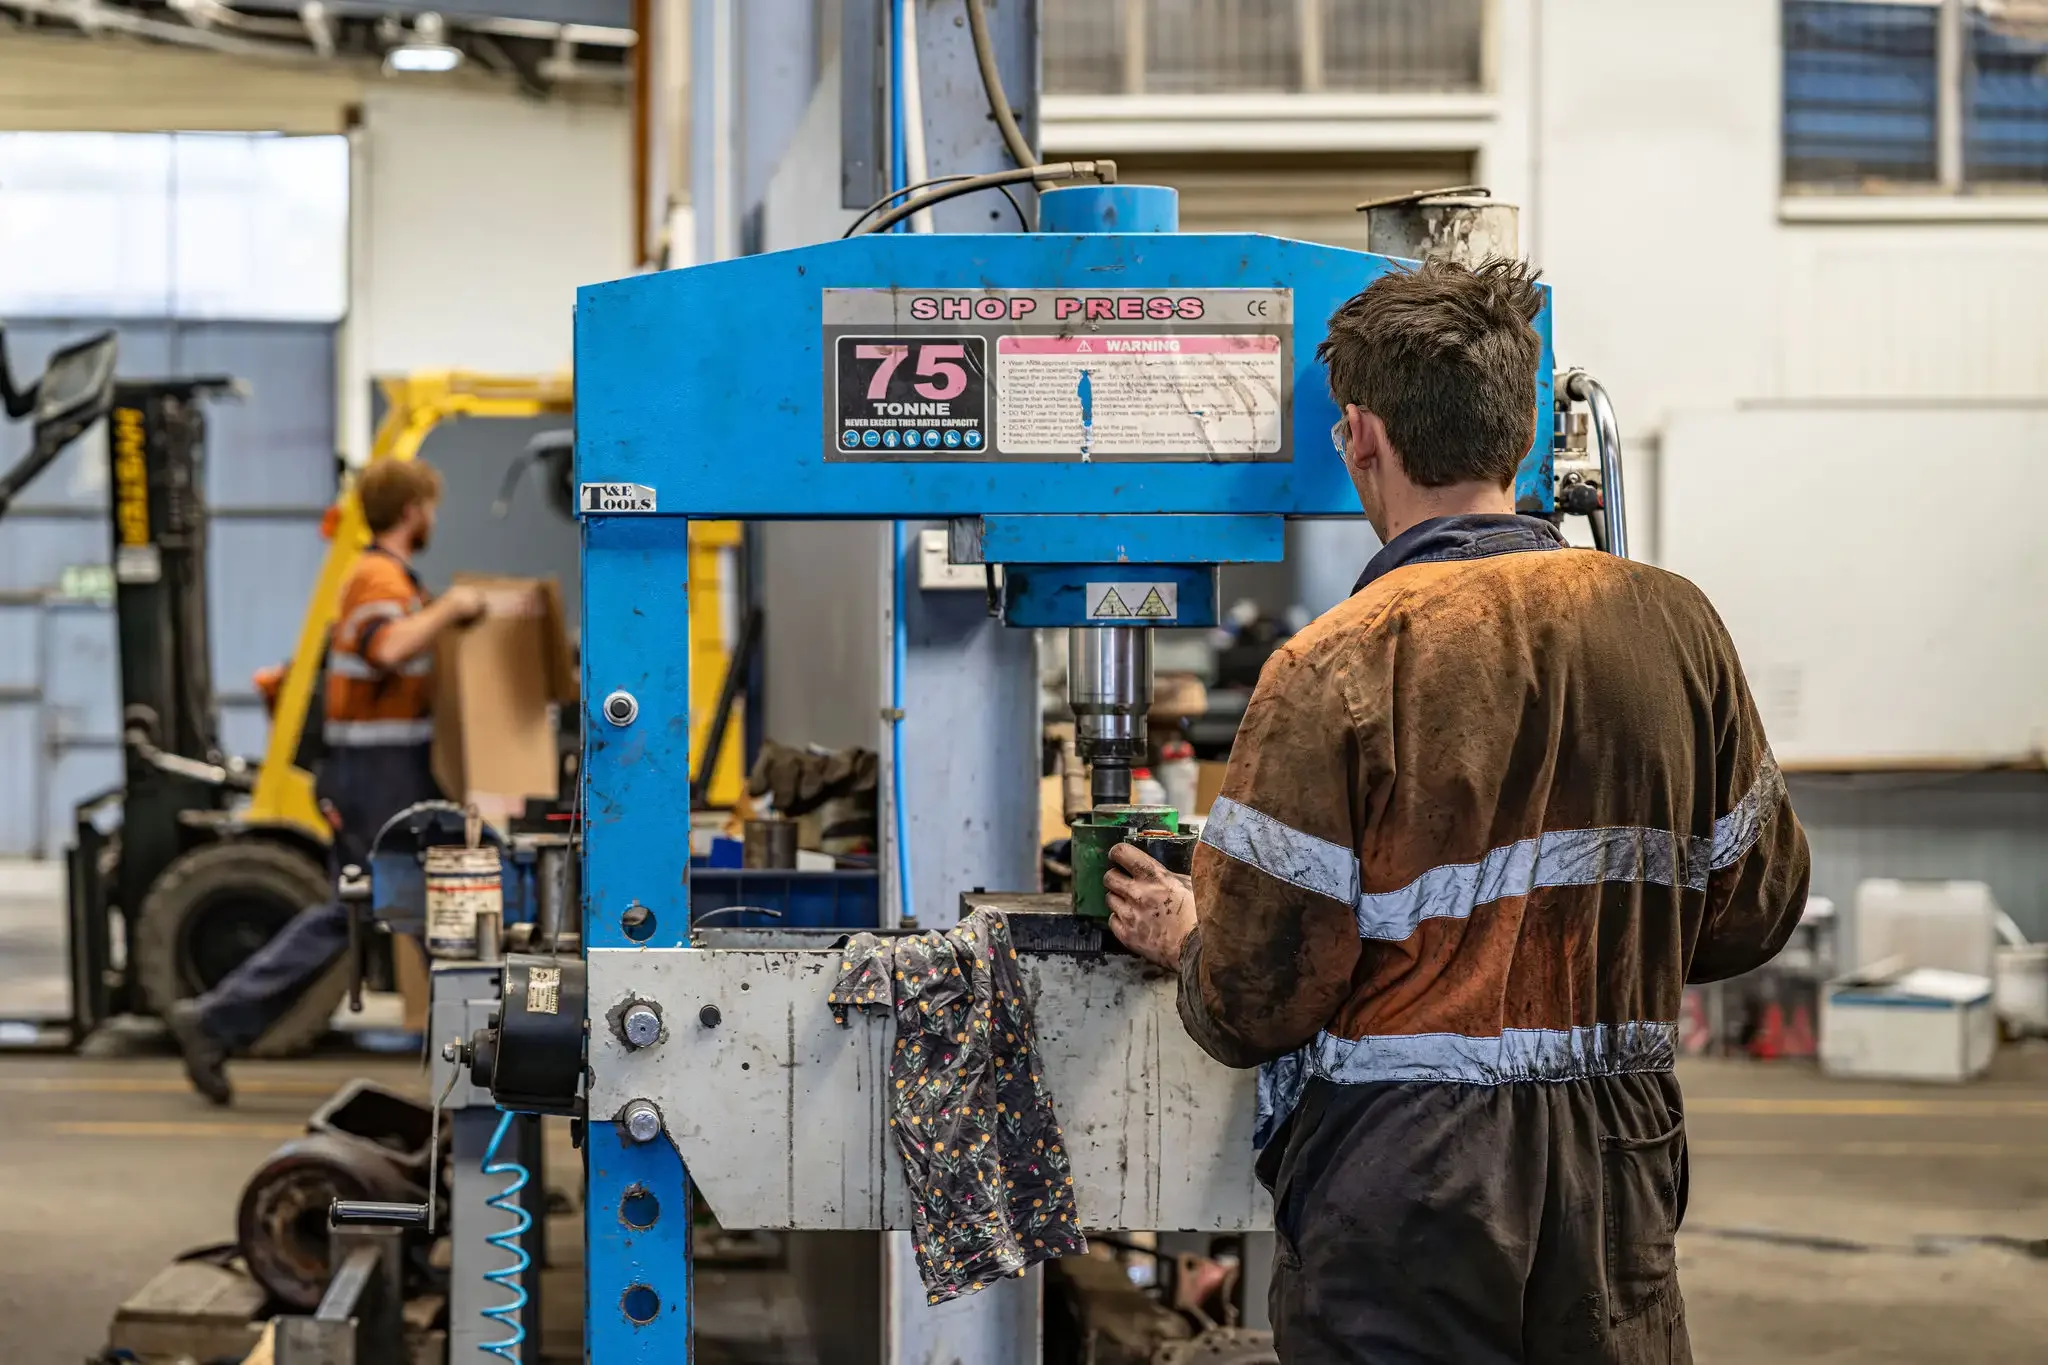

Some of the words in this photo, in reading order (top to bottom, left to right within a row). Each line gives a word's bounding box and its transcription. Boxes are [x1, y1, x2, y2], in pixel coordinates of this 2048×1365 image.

[911, 298, 1037, 320] SHOP
[1055, 298, 1204, 320] PRESS
[1248, 300, 1267, 317] CE
[1106, 340, 1180, 352] WARNING
[856, 345, 967, 400] 75
[873, 403, 950, 416] TONNE
[845, 418, 868, 427] NEVER
[870, 418, 897, 427] EXCEED
[898, 418, 916, 427] THIS
[917, 418, 941, 427] RATED
[941, 418, 979, 427] CAPACITY
